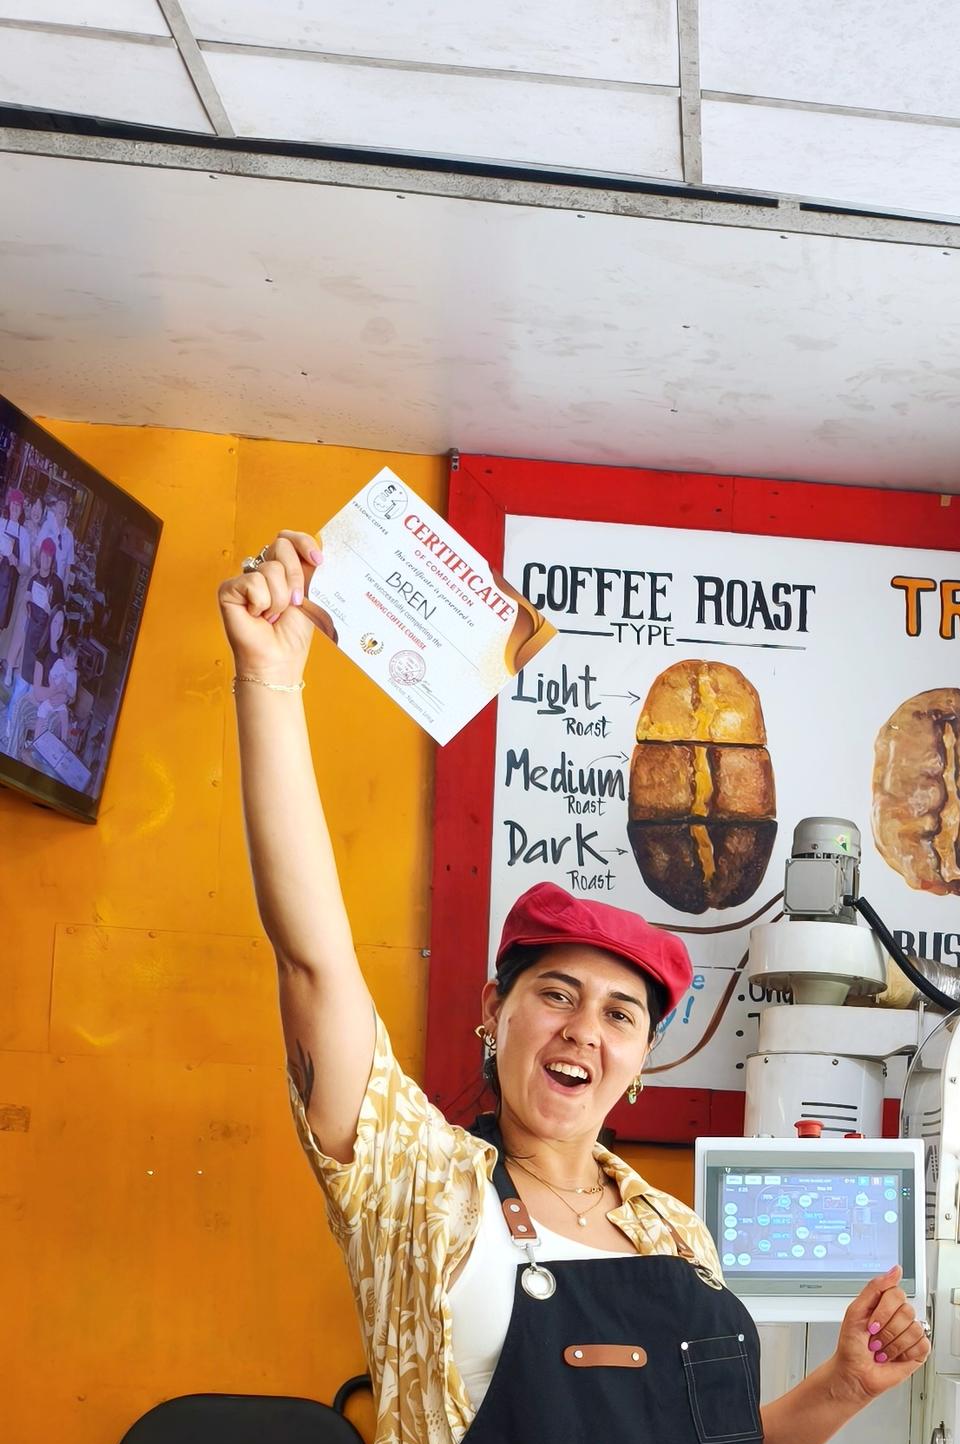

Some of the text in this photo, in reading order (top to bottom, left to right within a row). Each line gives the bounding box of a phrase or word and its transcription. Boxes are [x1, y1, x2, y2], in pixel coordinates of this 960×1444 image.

[393, 548, 407, 562] This
[404, 559, 434, 589] certificate
[437, 592, 468, 621] presented
[404, 514, 515, 622] CERTIFICATE
[413, 549, 474, 607] OF COMPLETION
[363, 590, 388, 614] MAKING
[385, 610, 407, 631] COFFEE
[403, 628, 427, 650] COURSE
[385, 570, 437, 620] BREN
[522, 561, 816, 633] COFFEE ROAST
[610, 621, 676, 647] TYPE
[511, 664, 602, 714] Light
[563, 715, 613, 739] Roast
[505, 748, 626, 801] Medium
[563, 794, 607, 817] Roast
[503, 819, 609, 867] Dark
[566, 868, 617, 892] Roast
